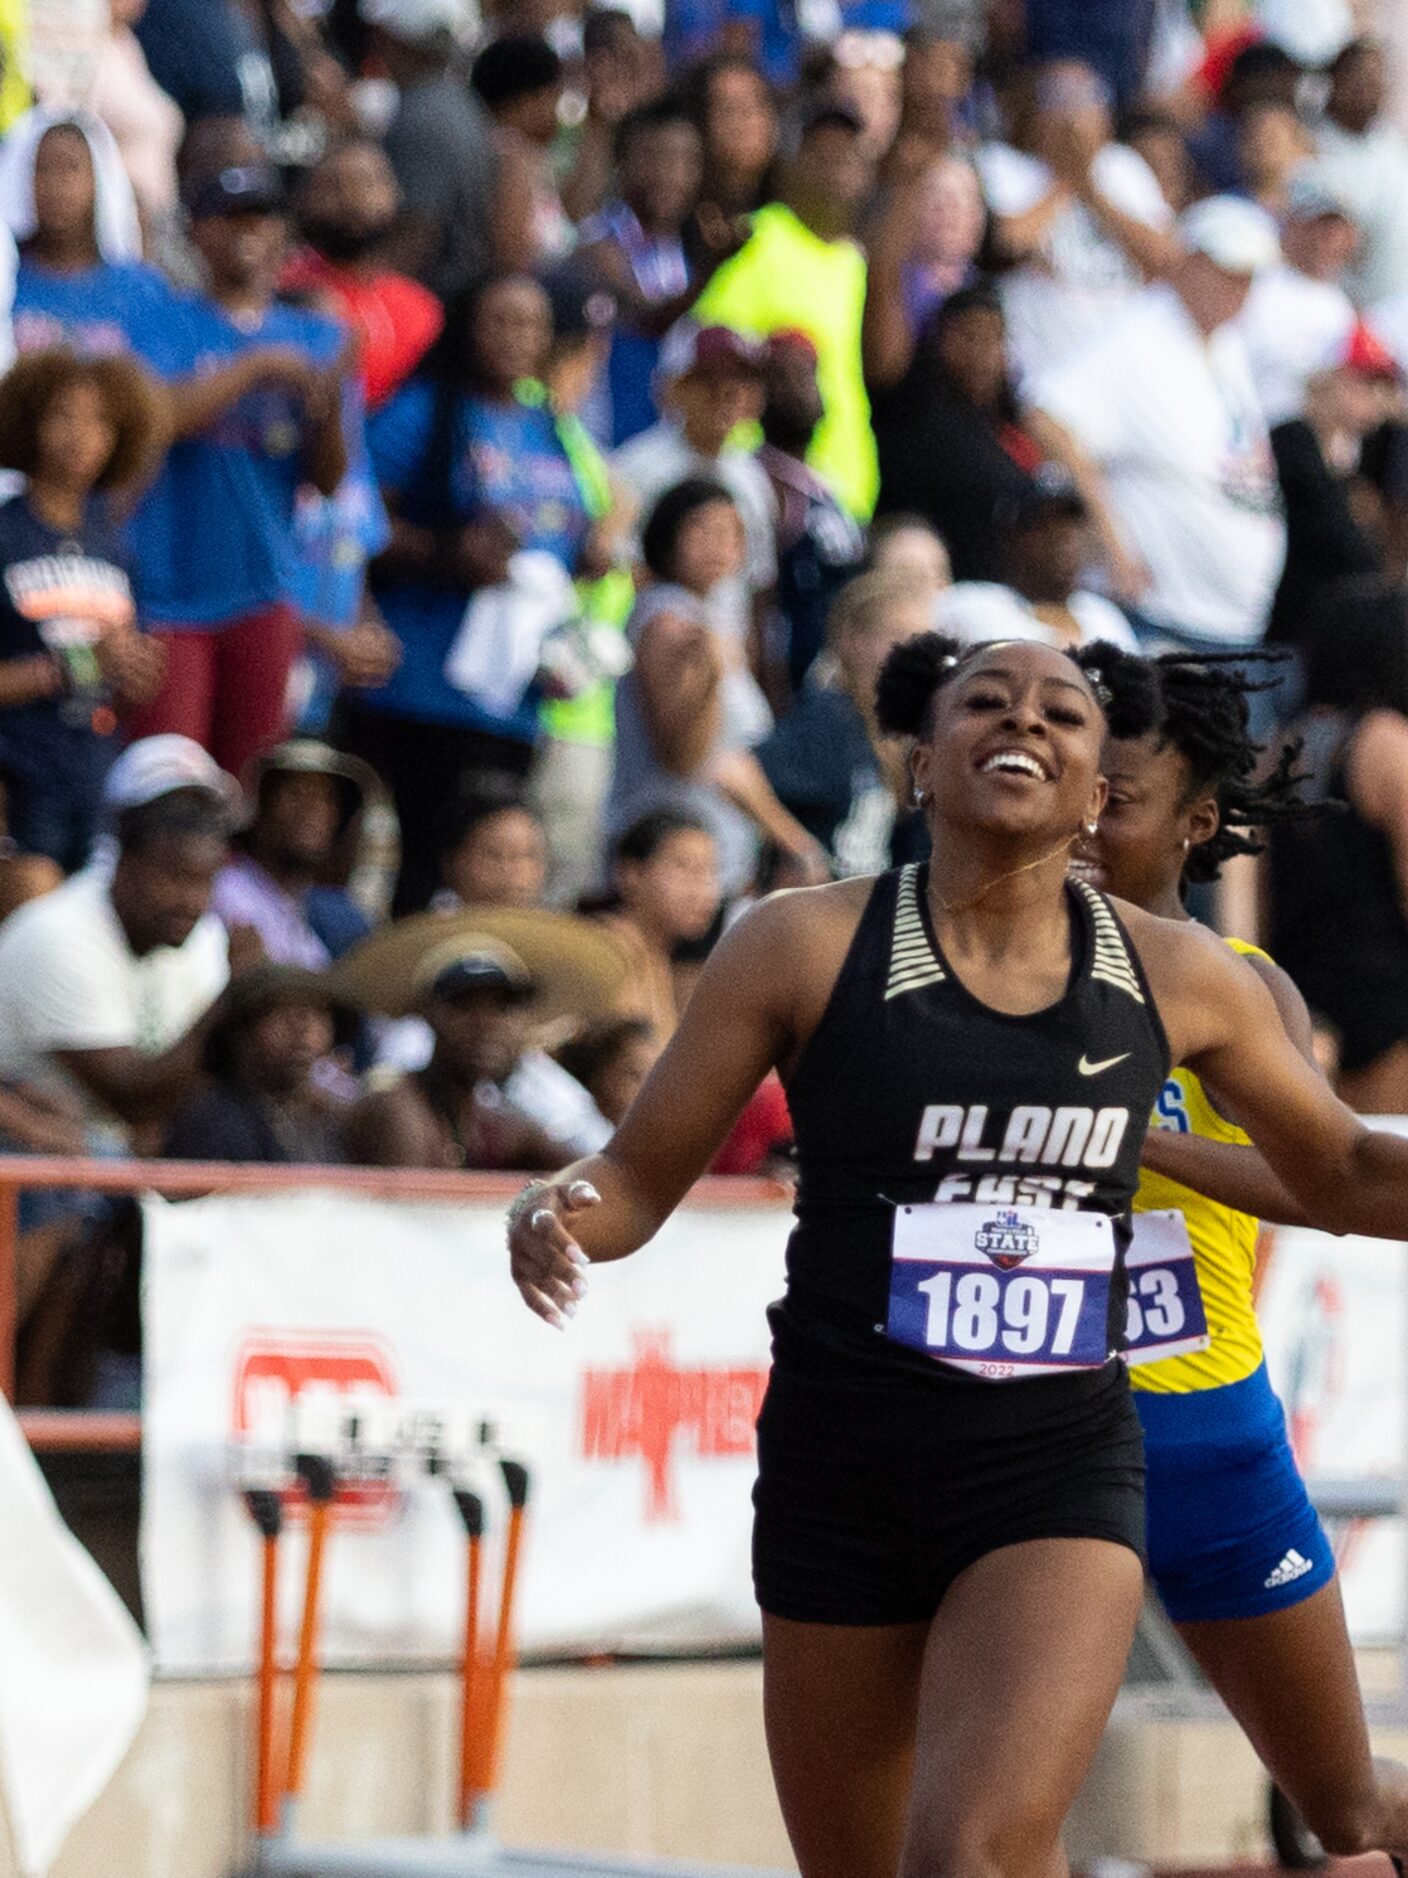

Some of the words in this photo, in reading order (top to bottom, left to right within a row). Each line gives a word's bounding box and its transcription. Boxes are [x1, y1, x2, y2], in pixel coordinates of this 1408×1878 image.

[913, 1104, 1129, 1168] PLANO
[976, 1232, 1039, 1250] STATE
[918, 1271, 1084, 1355] 1897
[979, 1363, 1014, 1377] 2022
